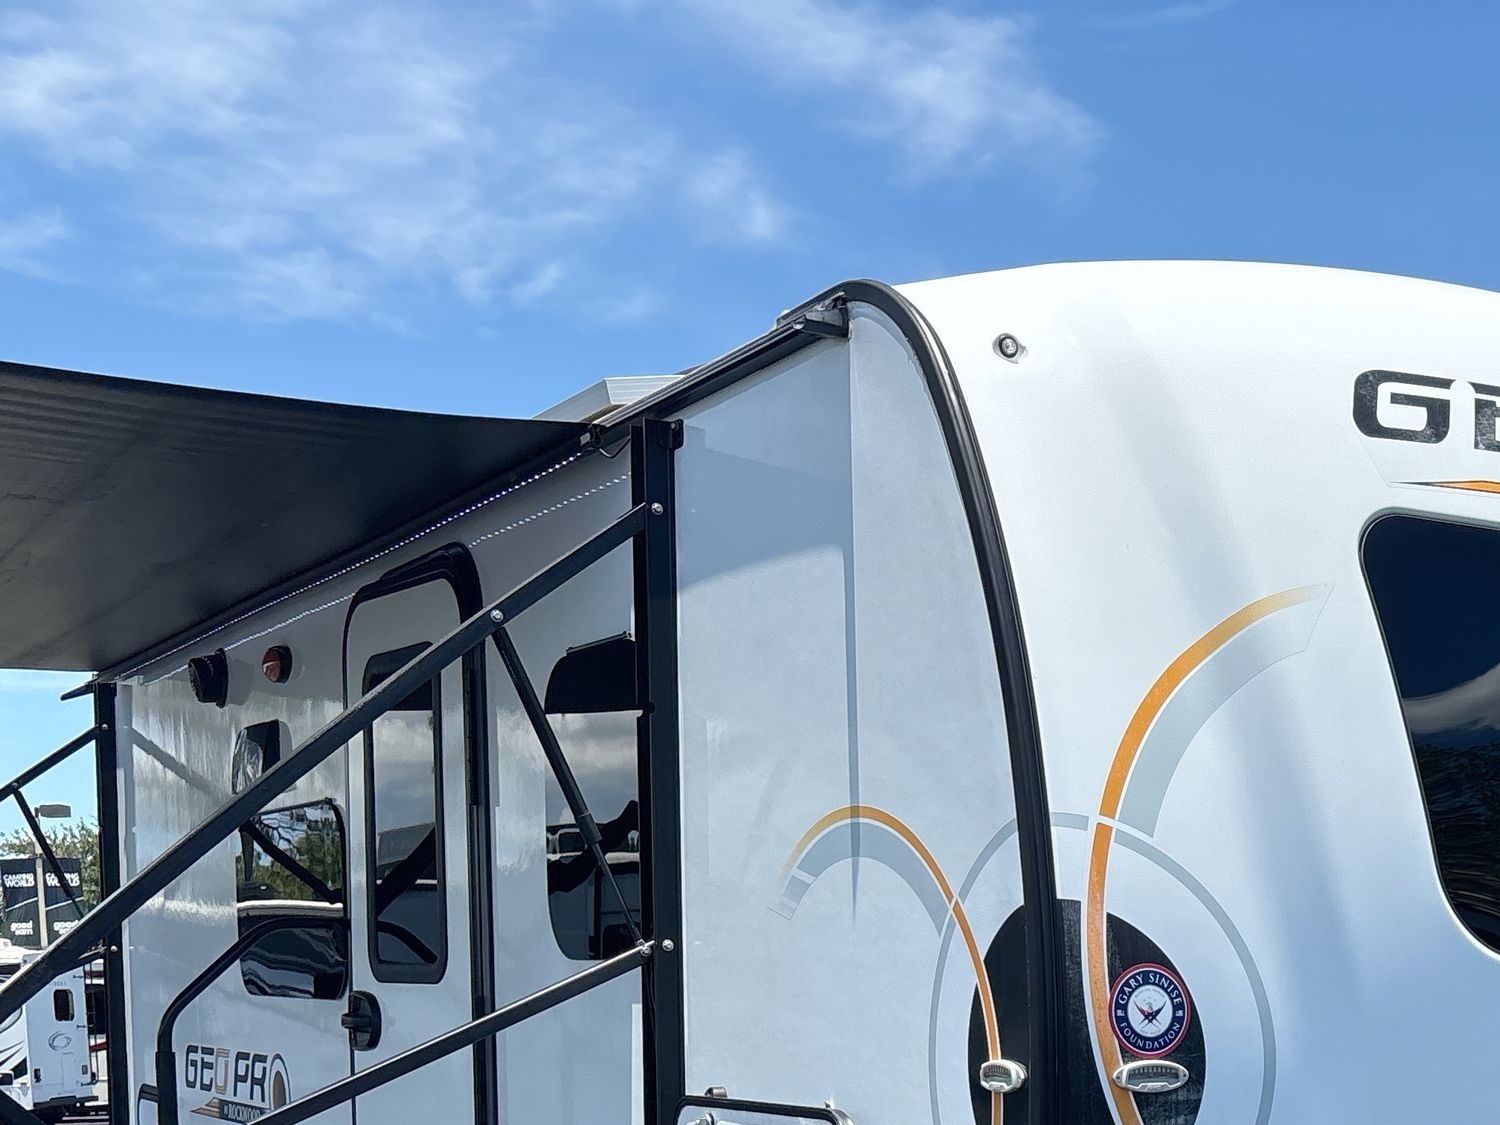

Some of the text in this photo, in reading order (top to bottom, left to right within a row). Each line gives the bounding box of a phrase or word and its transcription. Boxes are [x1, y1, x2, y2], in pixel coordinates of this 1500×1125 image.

[11, 920, 33, 932] good
[1118, 972, 1182, 1006] GARY SINISE
[1120, 1022, 1181, 1050] FOUNDATION
[185, 1044, 230, 1095] GEO
